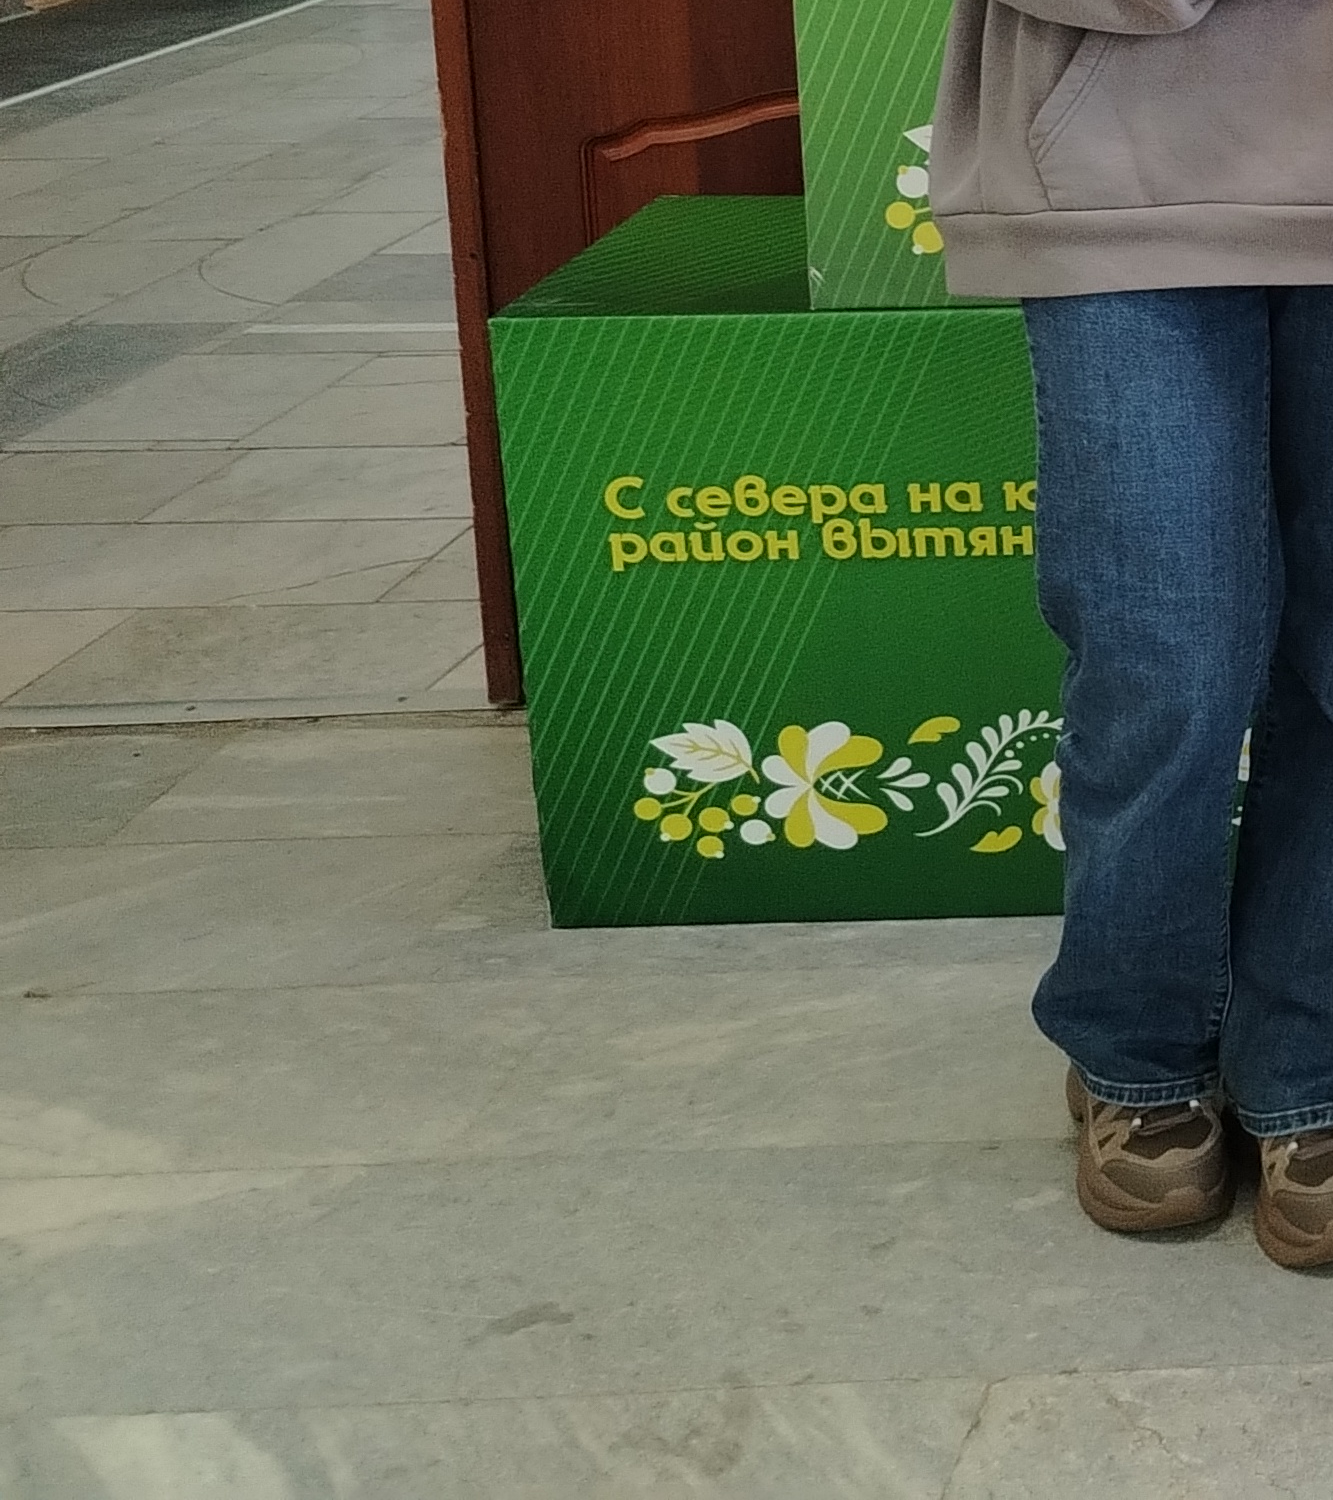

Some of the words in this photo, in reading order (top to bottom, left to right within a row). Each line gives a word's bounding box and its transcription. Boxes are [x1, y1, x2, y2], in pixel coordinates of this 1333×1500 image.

[604, 475, 645, 520] С
[666, 474, 889, 523] севера
[907, 480, 984, 513] на
[608, 521, 800, 572] район
[821, 518, 1034, 559] вытян
